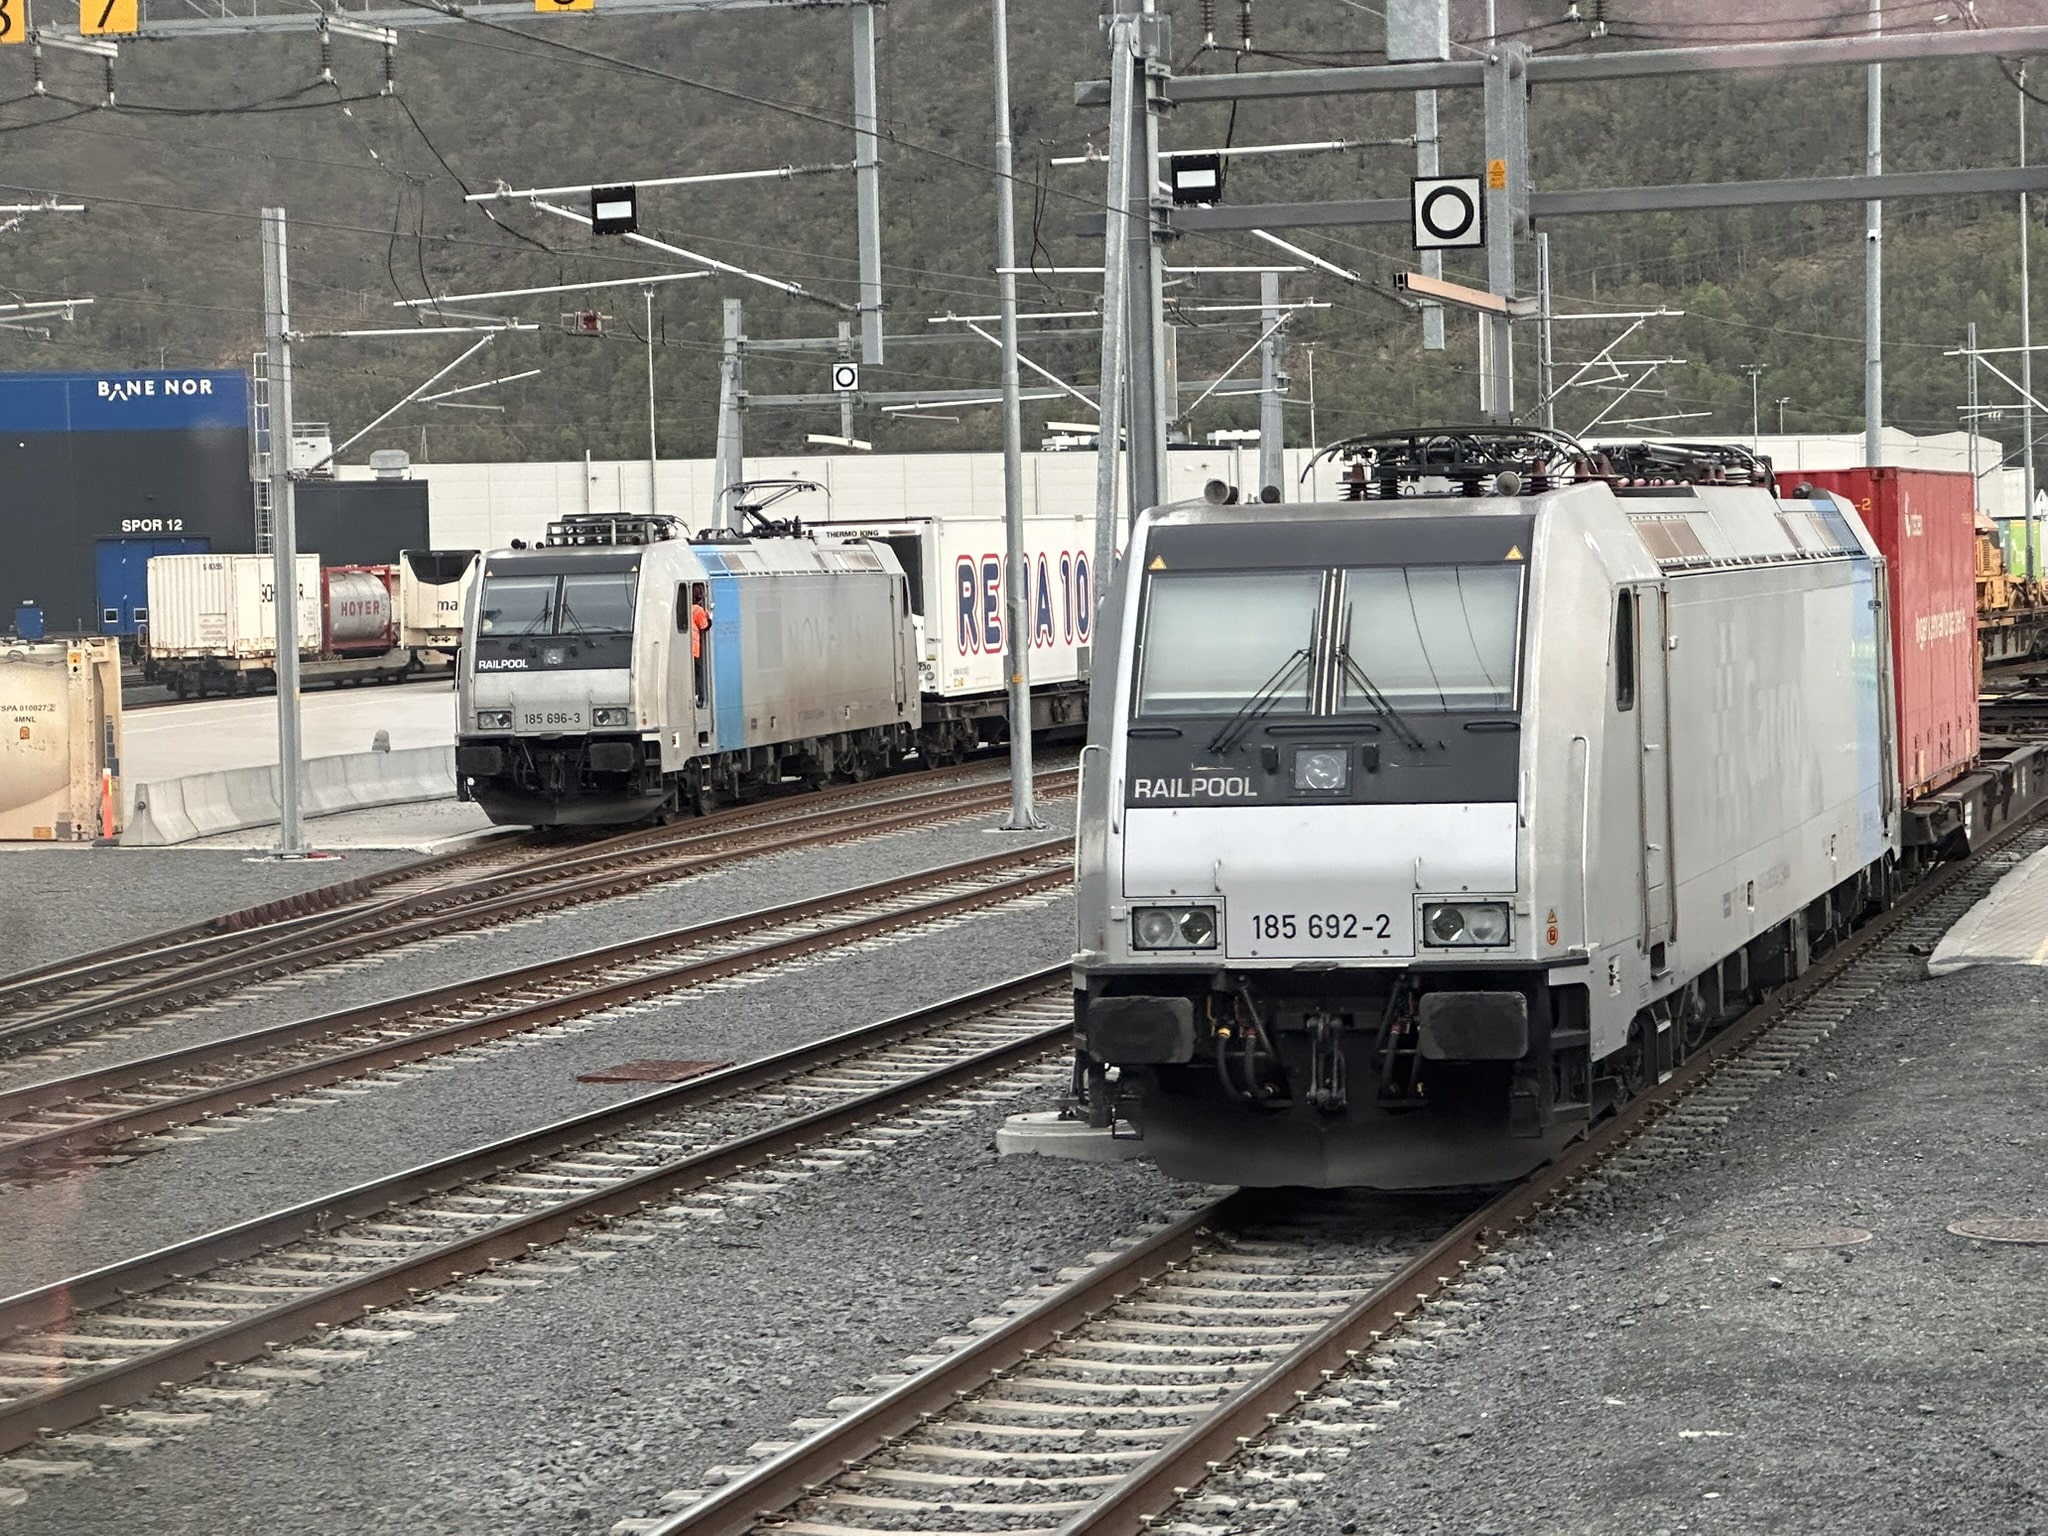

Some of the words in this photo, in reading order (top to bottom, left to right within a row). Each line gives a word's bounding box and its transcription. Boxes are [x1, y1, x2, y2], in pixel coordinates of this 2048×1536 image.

[98, 380, 155, 401] BANE
[165, 379, 212, 395] NOR
[121, 519, 162, 532] SPOR
[166, 518, 183, 531] 12
[826, 530, 858, 538] THERMO
[860, 529, 879, 537] KING
[341, 600, 380, 617] HOYER
[478, 658, 529, 670] RAILPOOL
[0, 703, 18, 712] SPA
[524, 714, 543, 725] 185
[546, 712, 581, 724] 696-3
[1134, 777, 1258, 799] RAILPOOL
[1252, 914, 1297, 939] 185
[1308, 913, 1392, 939] 692-2
